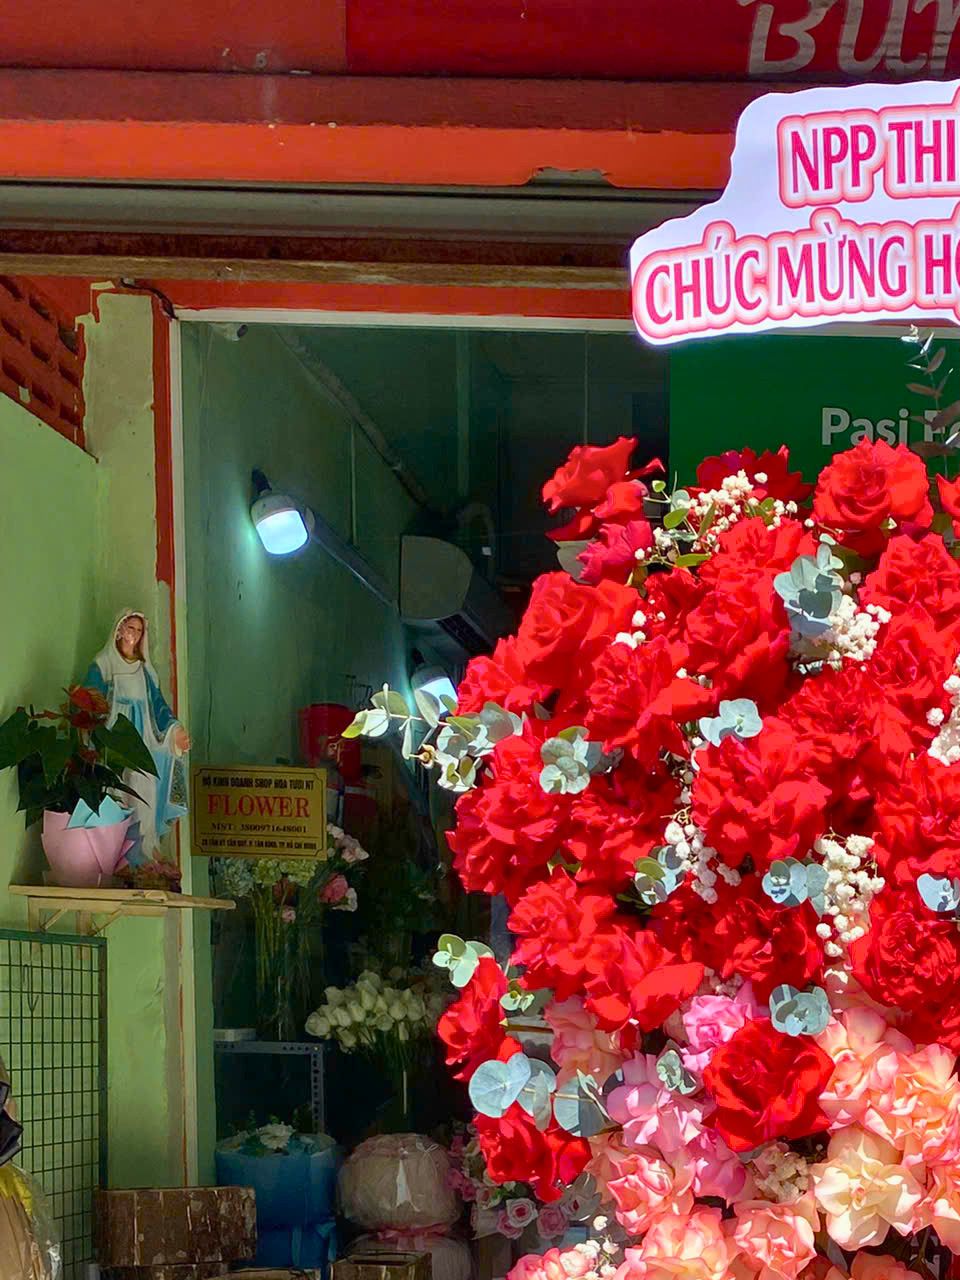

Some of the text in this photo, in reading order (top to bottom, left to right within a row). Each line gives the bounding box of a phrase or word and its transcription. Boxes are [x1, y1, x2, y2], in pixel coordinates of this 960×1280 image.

[791, 123, 877, 194] NPP
[645, 235, 762, 326] CHÚC
[776, 221, 907, 306] MỪNG
[821, 407, 909, 446] Pasi
[207, 793, 310, 818] FLOWER
